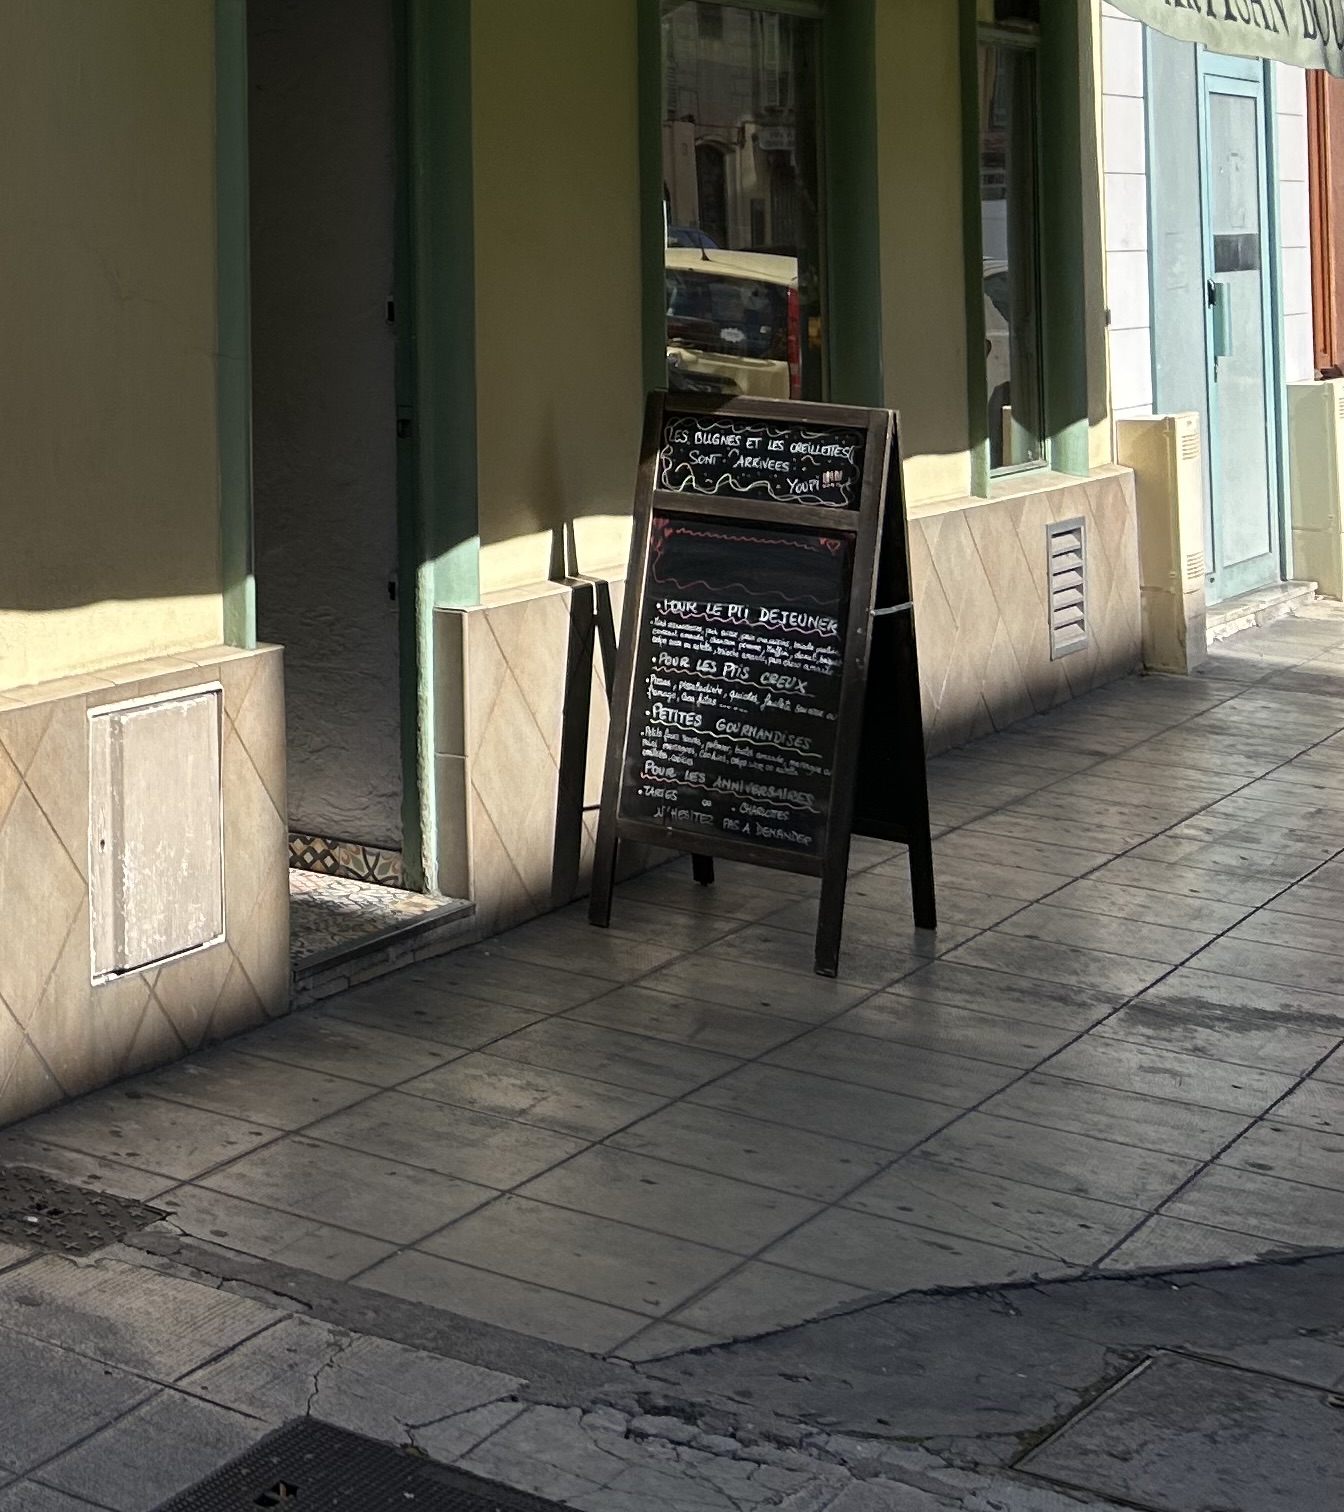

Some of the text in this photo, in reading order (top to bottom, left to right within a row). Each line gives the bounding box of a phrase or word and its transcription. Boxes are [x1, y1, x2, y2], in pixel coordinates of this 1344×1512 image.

[669, 429, 690, 444] LES
[694, 431, 741, 447] BUGNES
[745, 437, 763, 450] ET
[767, 439, 785, 451] LES
[689, 450, 722, 466] SONT
[705, 603, 723, 616] LE
[659, 651, 691, 668] POUR
[696, 659, 717, 674] LES
[759, 671, 808, 694] CREUX
[652, 702, 703, 728] PETITES
[715, 718, 813, 750] GOURMANDISES
[644, 759, 815, 806] POUR LES ANNIVERSAIRES
[722, 817, 741, 831] PAS
[741, 822, 751, 835] A
[755, 821, 813, 846] DEMANDER
